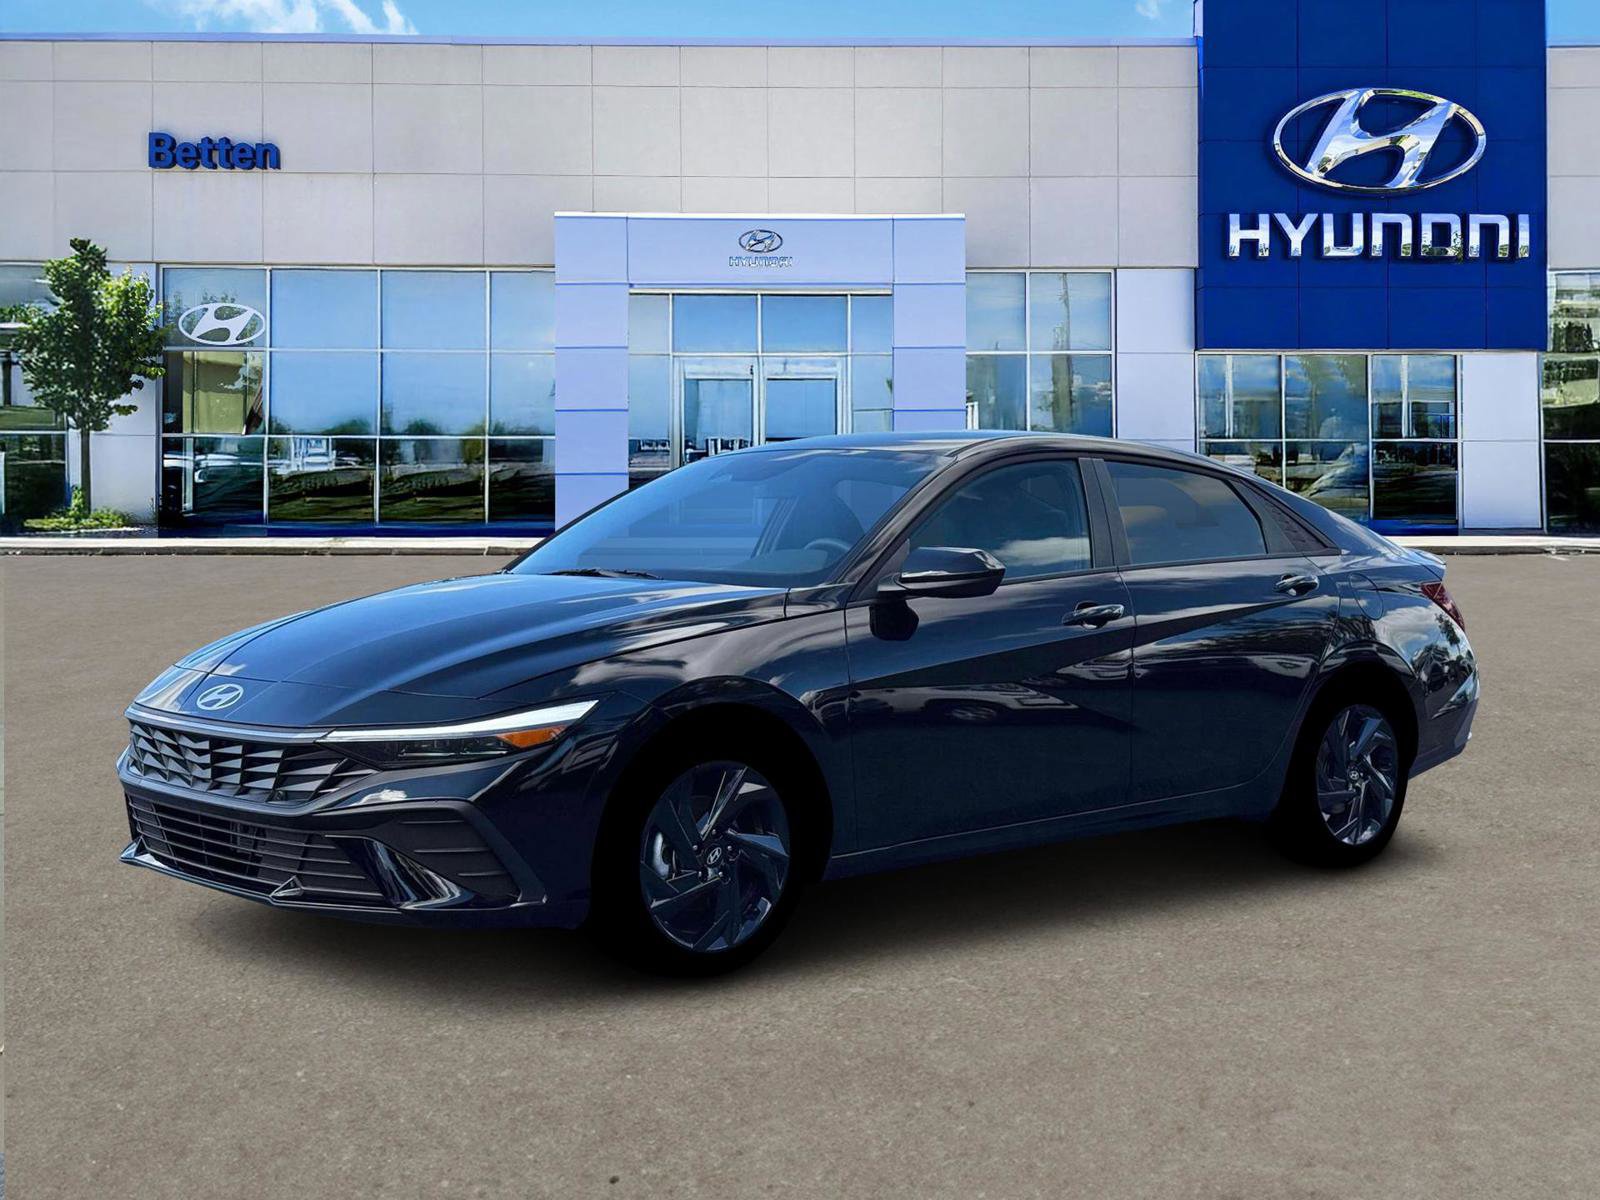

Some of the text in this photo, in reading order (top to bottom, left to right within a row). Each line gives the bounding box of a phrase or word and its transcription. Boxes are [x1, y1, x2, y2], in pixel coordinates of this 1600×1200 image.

[148, 131, 281, 170] Betten
[1228, 212, 1531, 259] HYUNDAI
[728, 255, 793, 268] HYUNDAI
